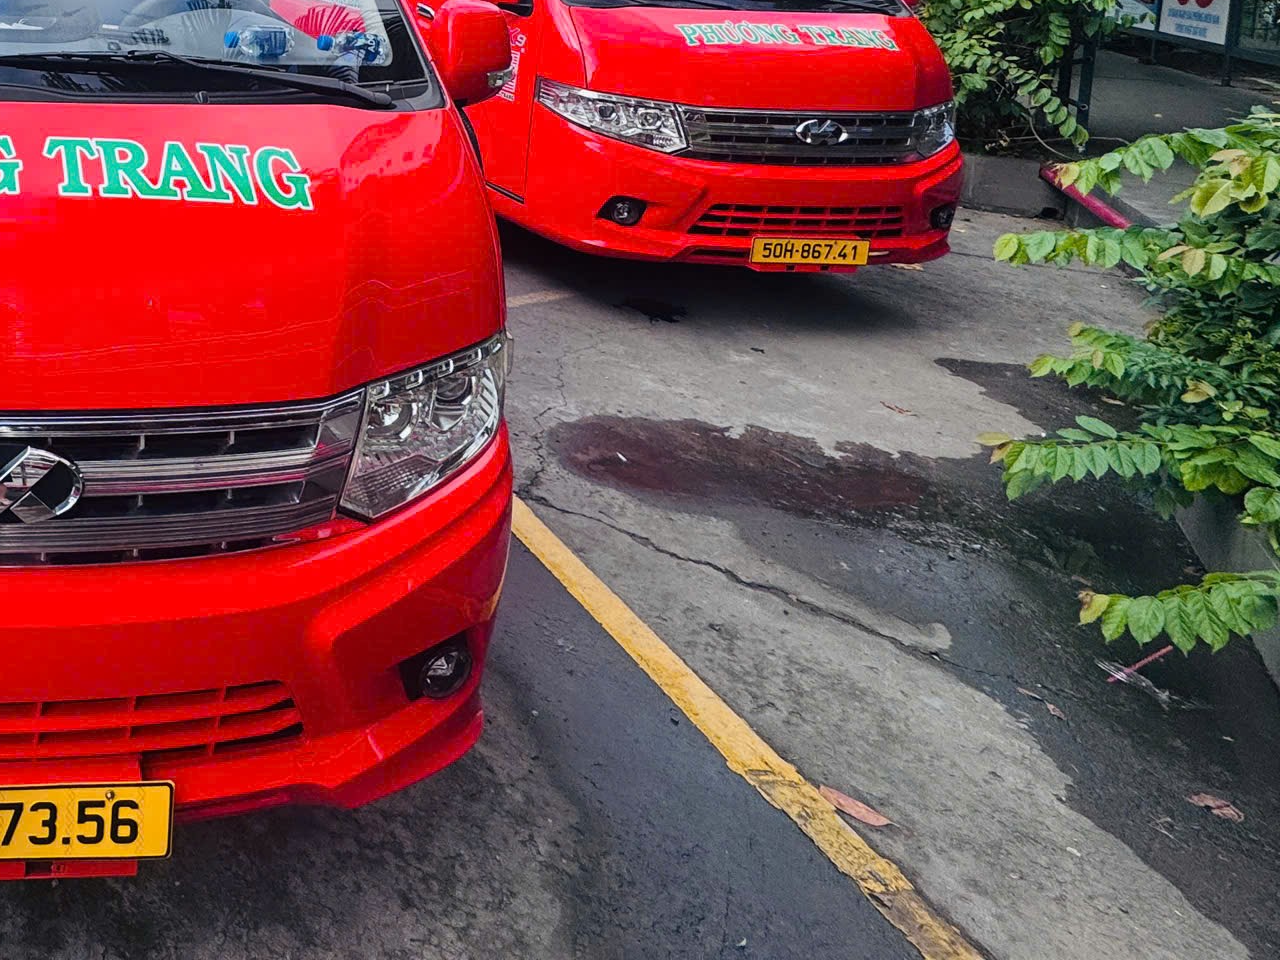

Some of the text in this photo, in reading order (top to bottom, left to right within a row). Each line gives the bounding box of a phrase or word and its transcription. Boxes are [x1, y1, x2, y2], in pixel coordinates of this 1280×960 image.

[675, 20, 900, 52] PHƯƠNG TRANG
[42, 136, 314, 210] TRANG
[761, 241, 859, 261] 50H-867.41
